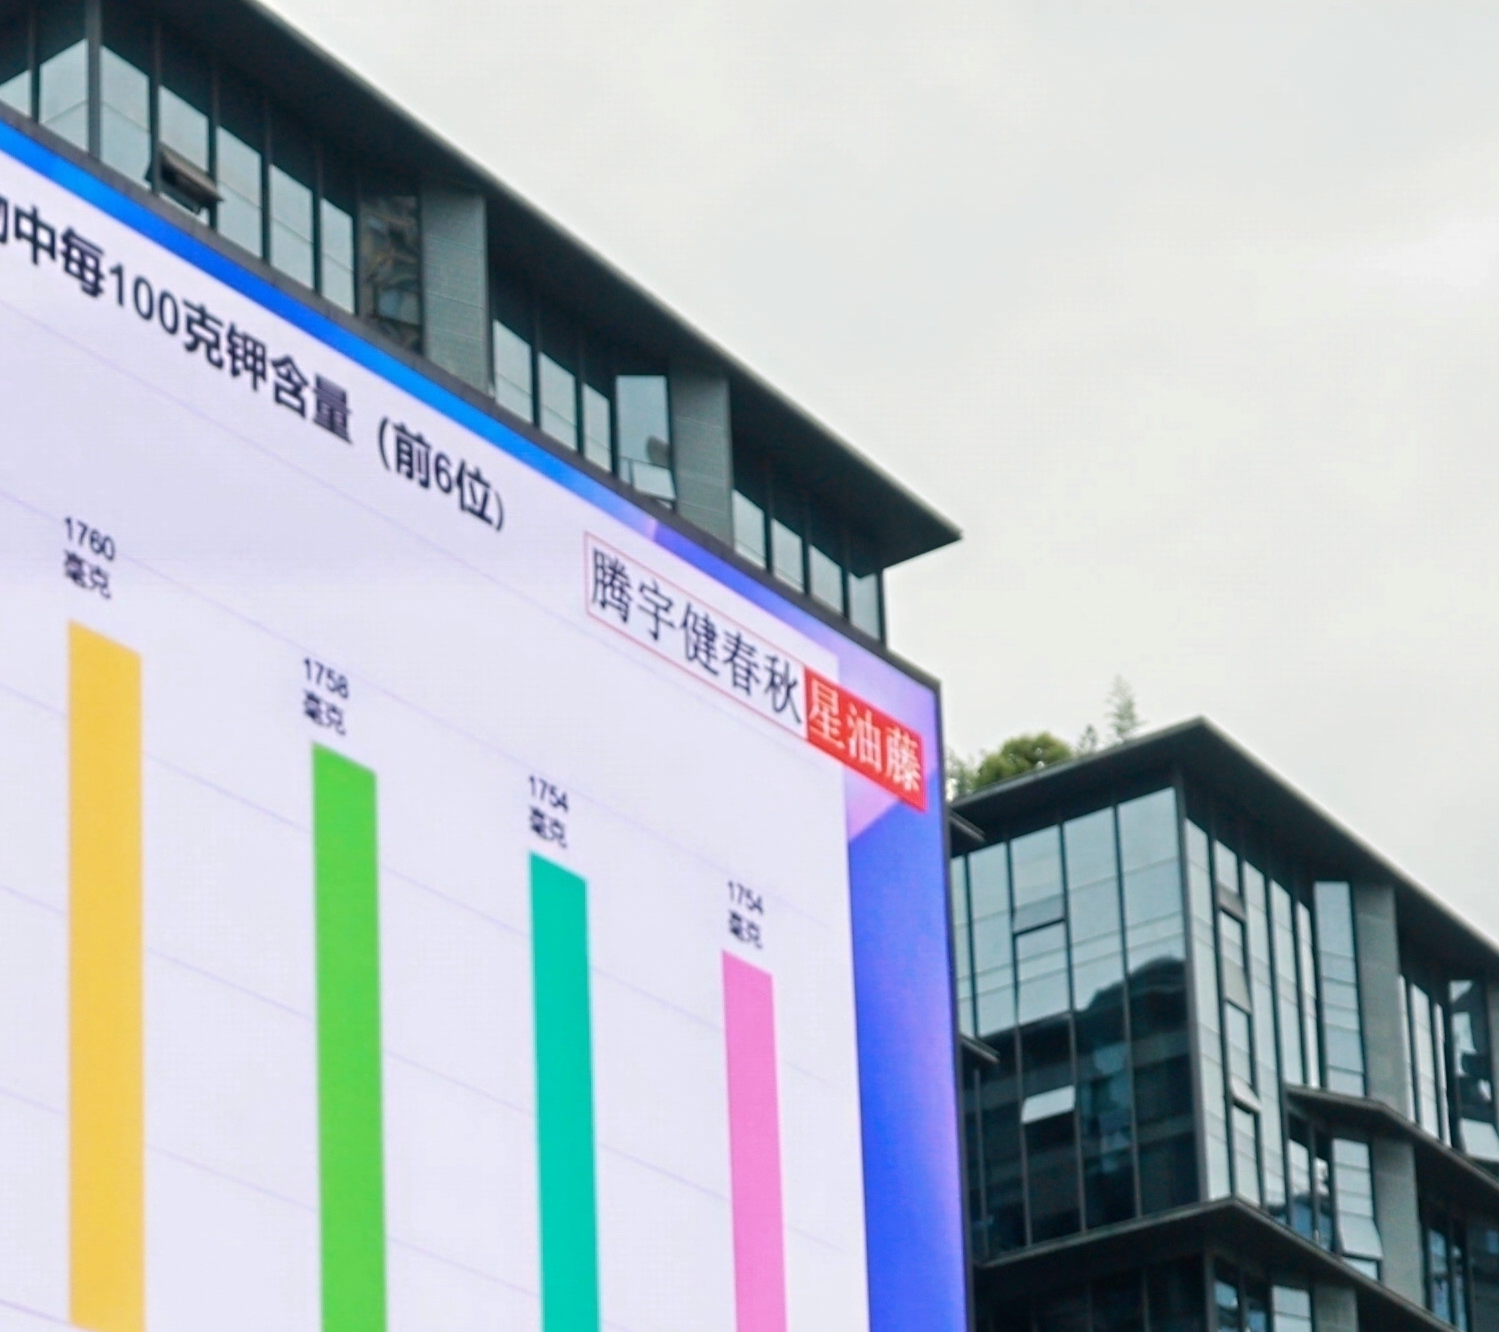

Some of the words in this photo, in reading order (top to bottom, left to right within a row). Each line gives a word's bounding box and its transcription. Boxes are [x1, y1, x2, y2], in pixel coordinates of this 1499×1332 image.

[63, 515, 116, 562] 1760
[63, 548, 111, 600] 毫克
[303, 657, 349, 699] 1758
[303, 689, 347, 736] 毫克
[528, 775, 569, 814] 1754
[528, 805, 568, 849] 毫克
[727, 880, 764, 916] 1754
[727, 910, 763, 950] 毫克
